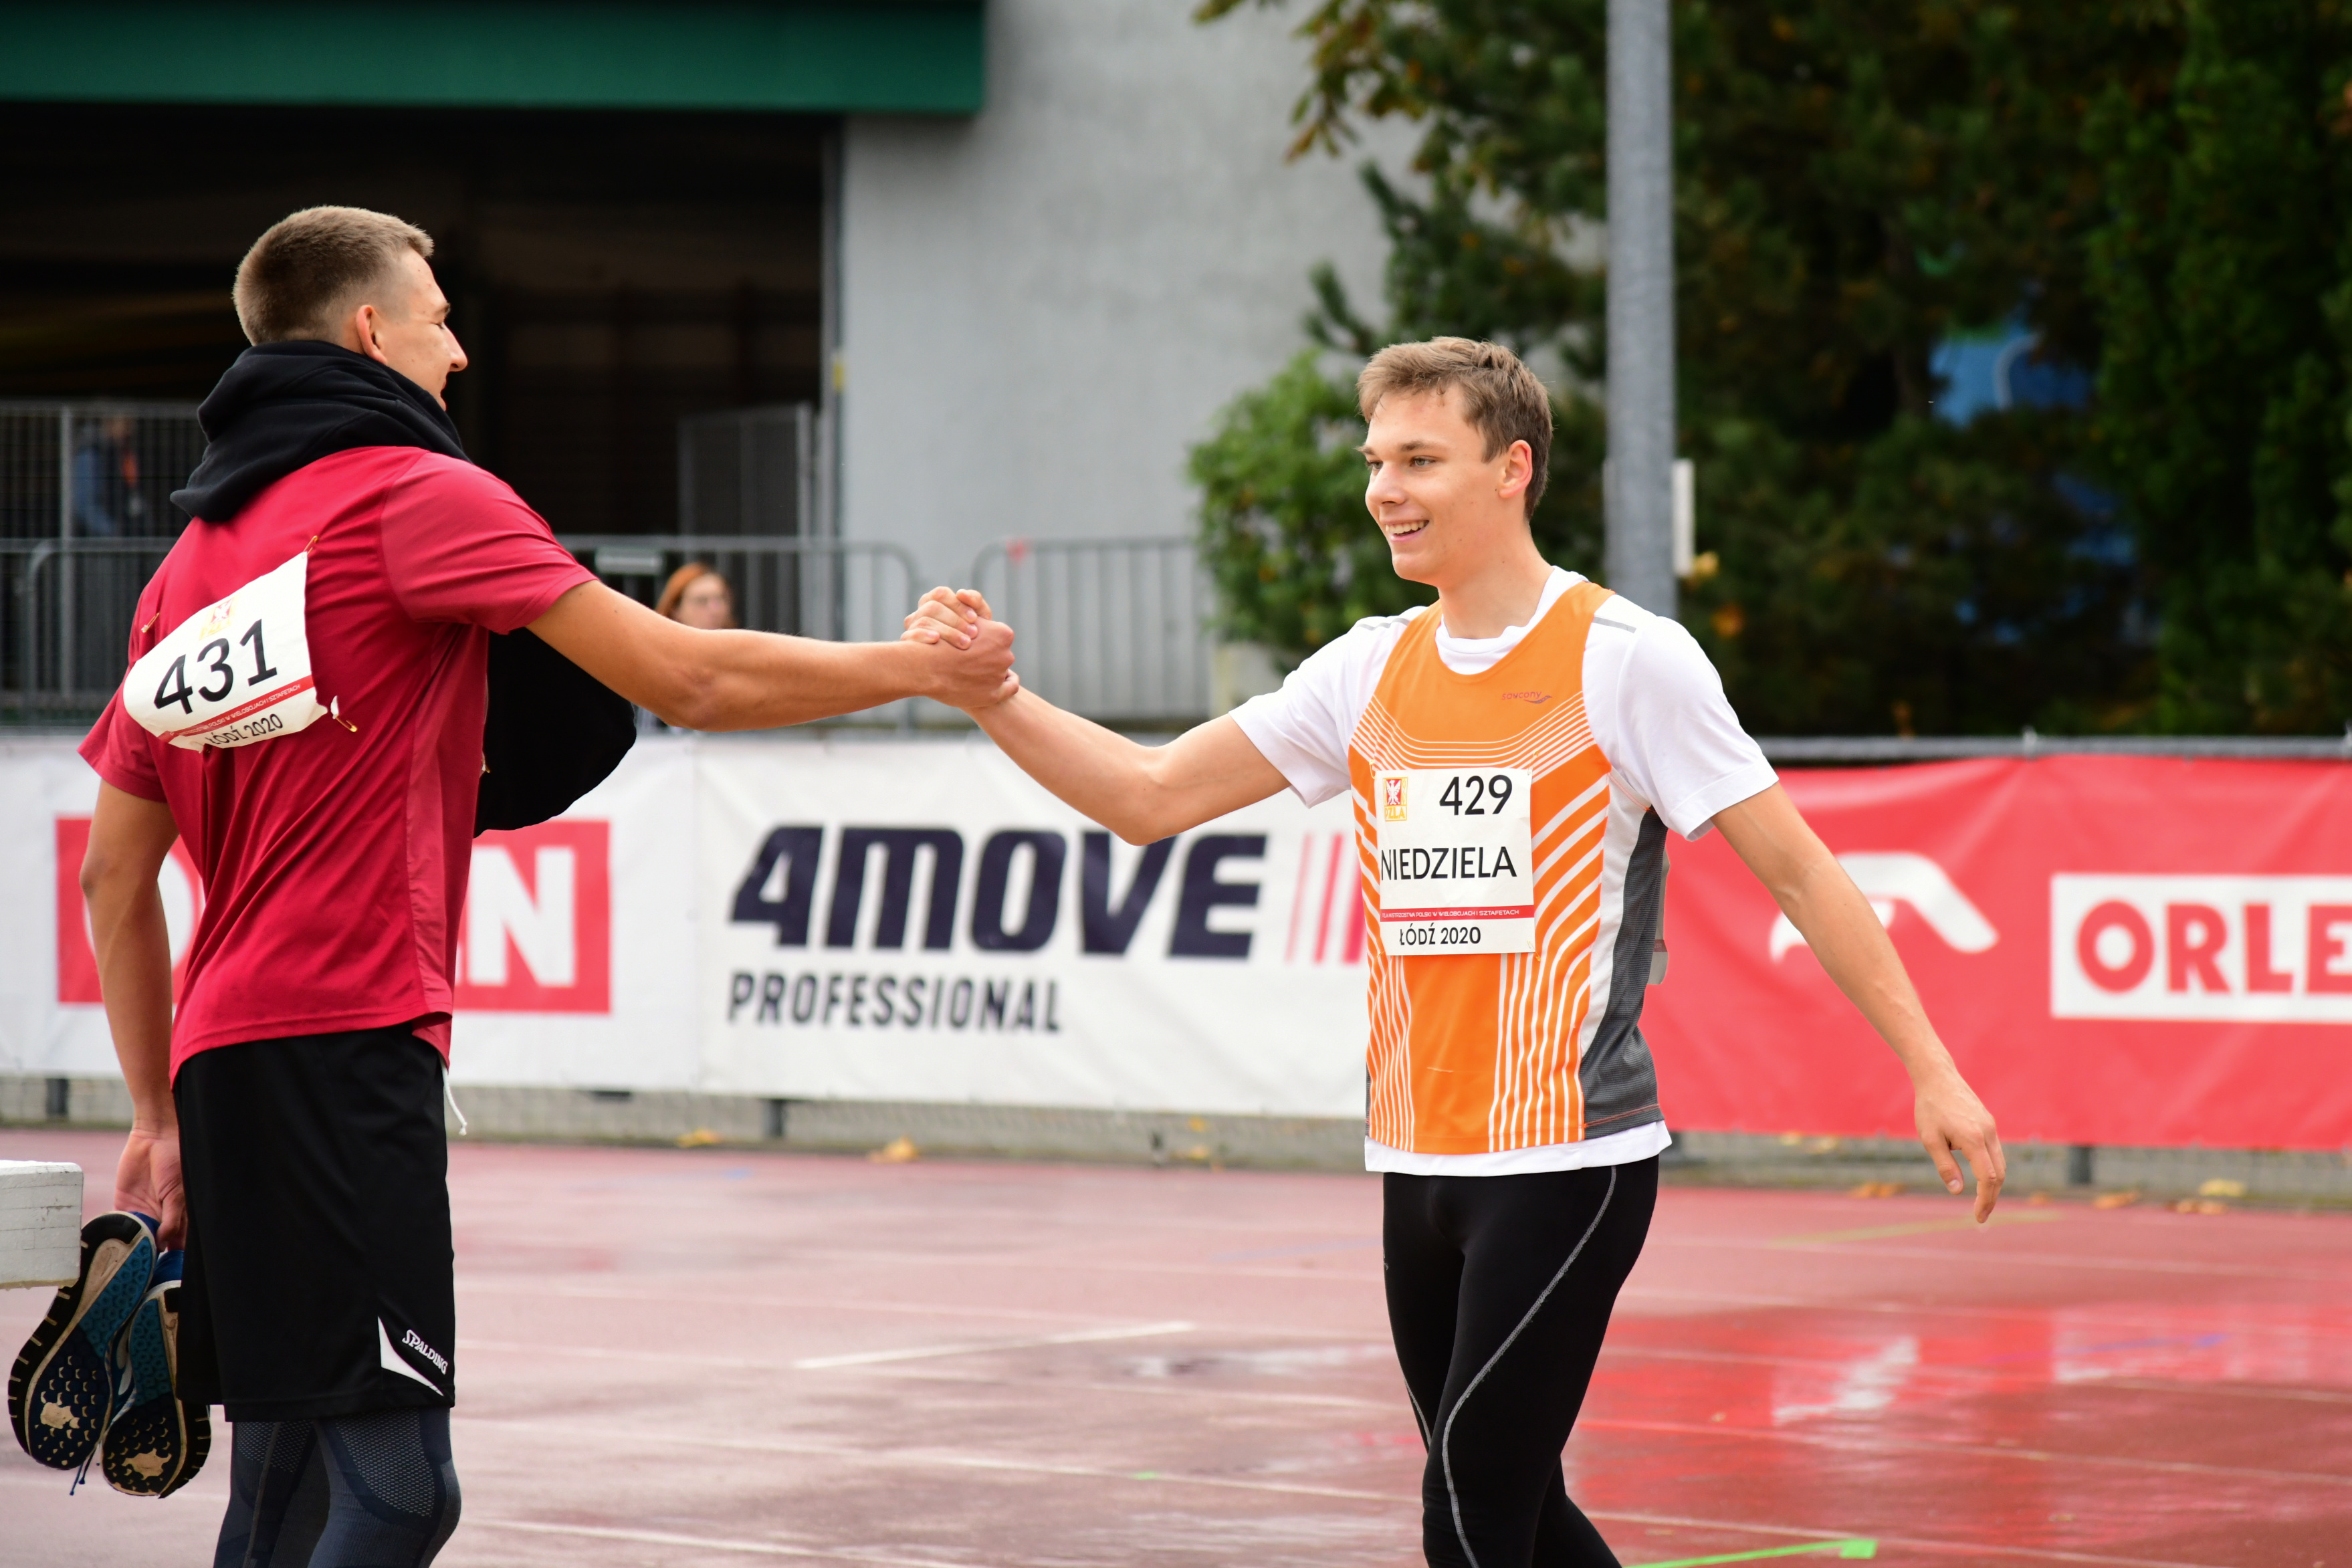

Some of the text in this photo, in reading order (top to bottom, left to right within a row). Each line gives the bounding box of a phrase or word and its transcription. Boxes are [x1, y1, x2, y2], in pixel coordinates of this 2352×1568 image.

[153, 619, 278, 715] 431
[268, 684, 300, 702] SZTAFETACH
[1502, 691, 1542, 700] saucony
[205, 725, 248, 745] ŁÓDŹ
[243, 713, 283, 736] 2020
[1439, 774, 1513, 816] 429
[1381, 846, 1517, 881] NIEDZIELA
[729, 825, 1267, 960] 4MOVE
[1400, 922, 1481, 945] ŁÓDŹ 2020
[729, 972, 1061, 1032] PROFESSIONAL
[402, 1329, 448, 1375] SPALDING
